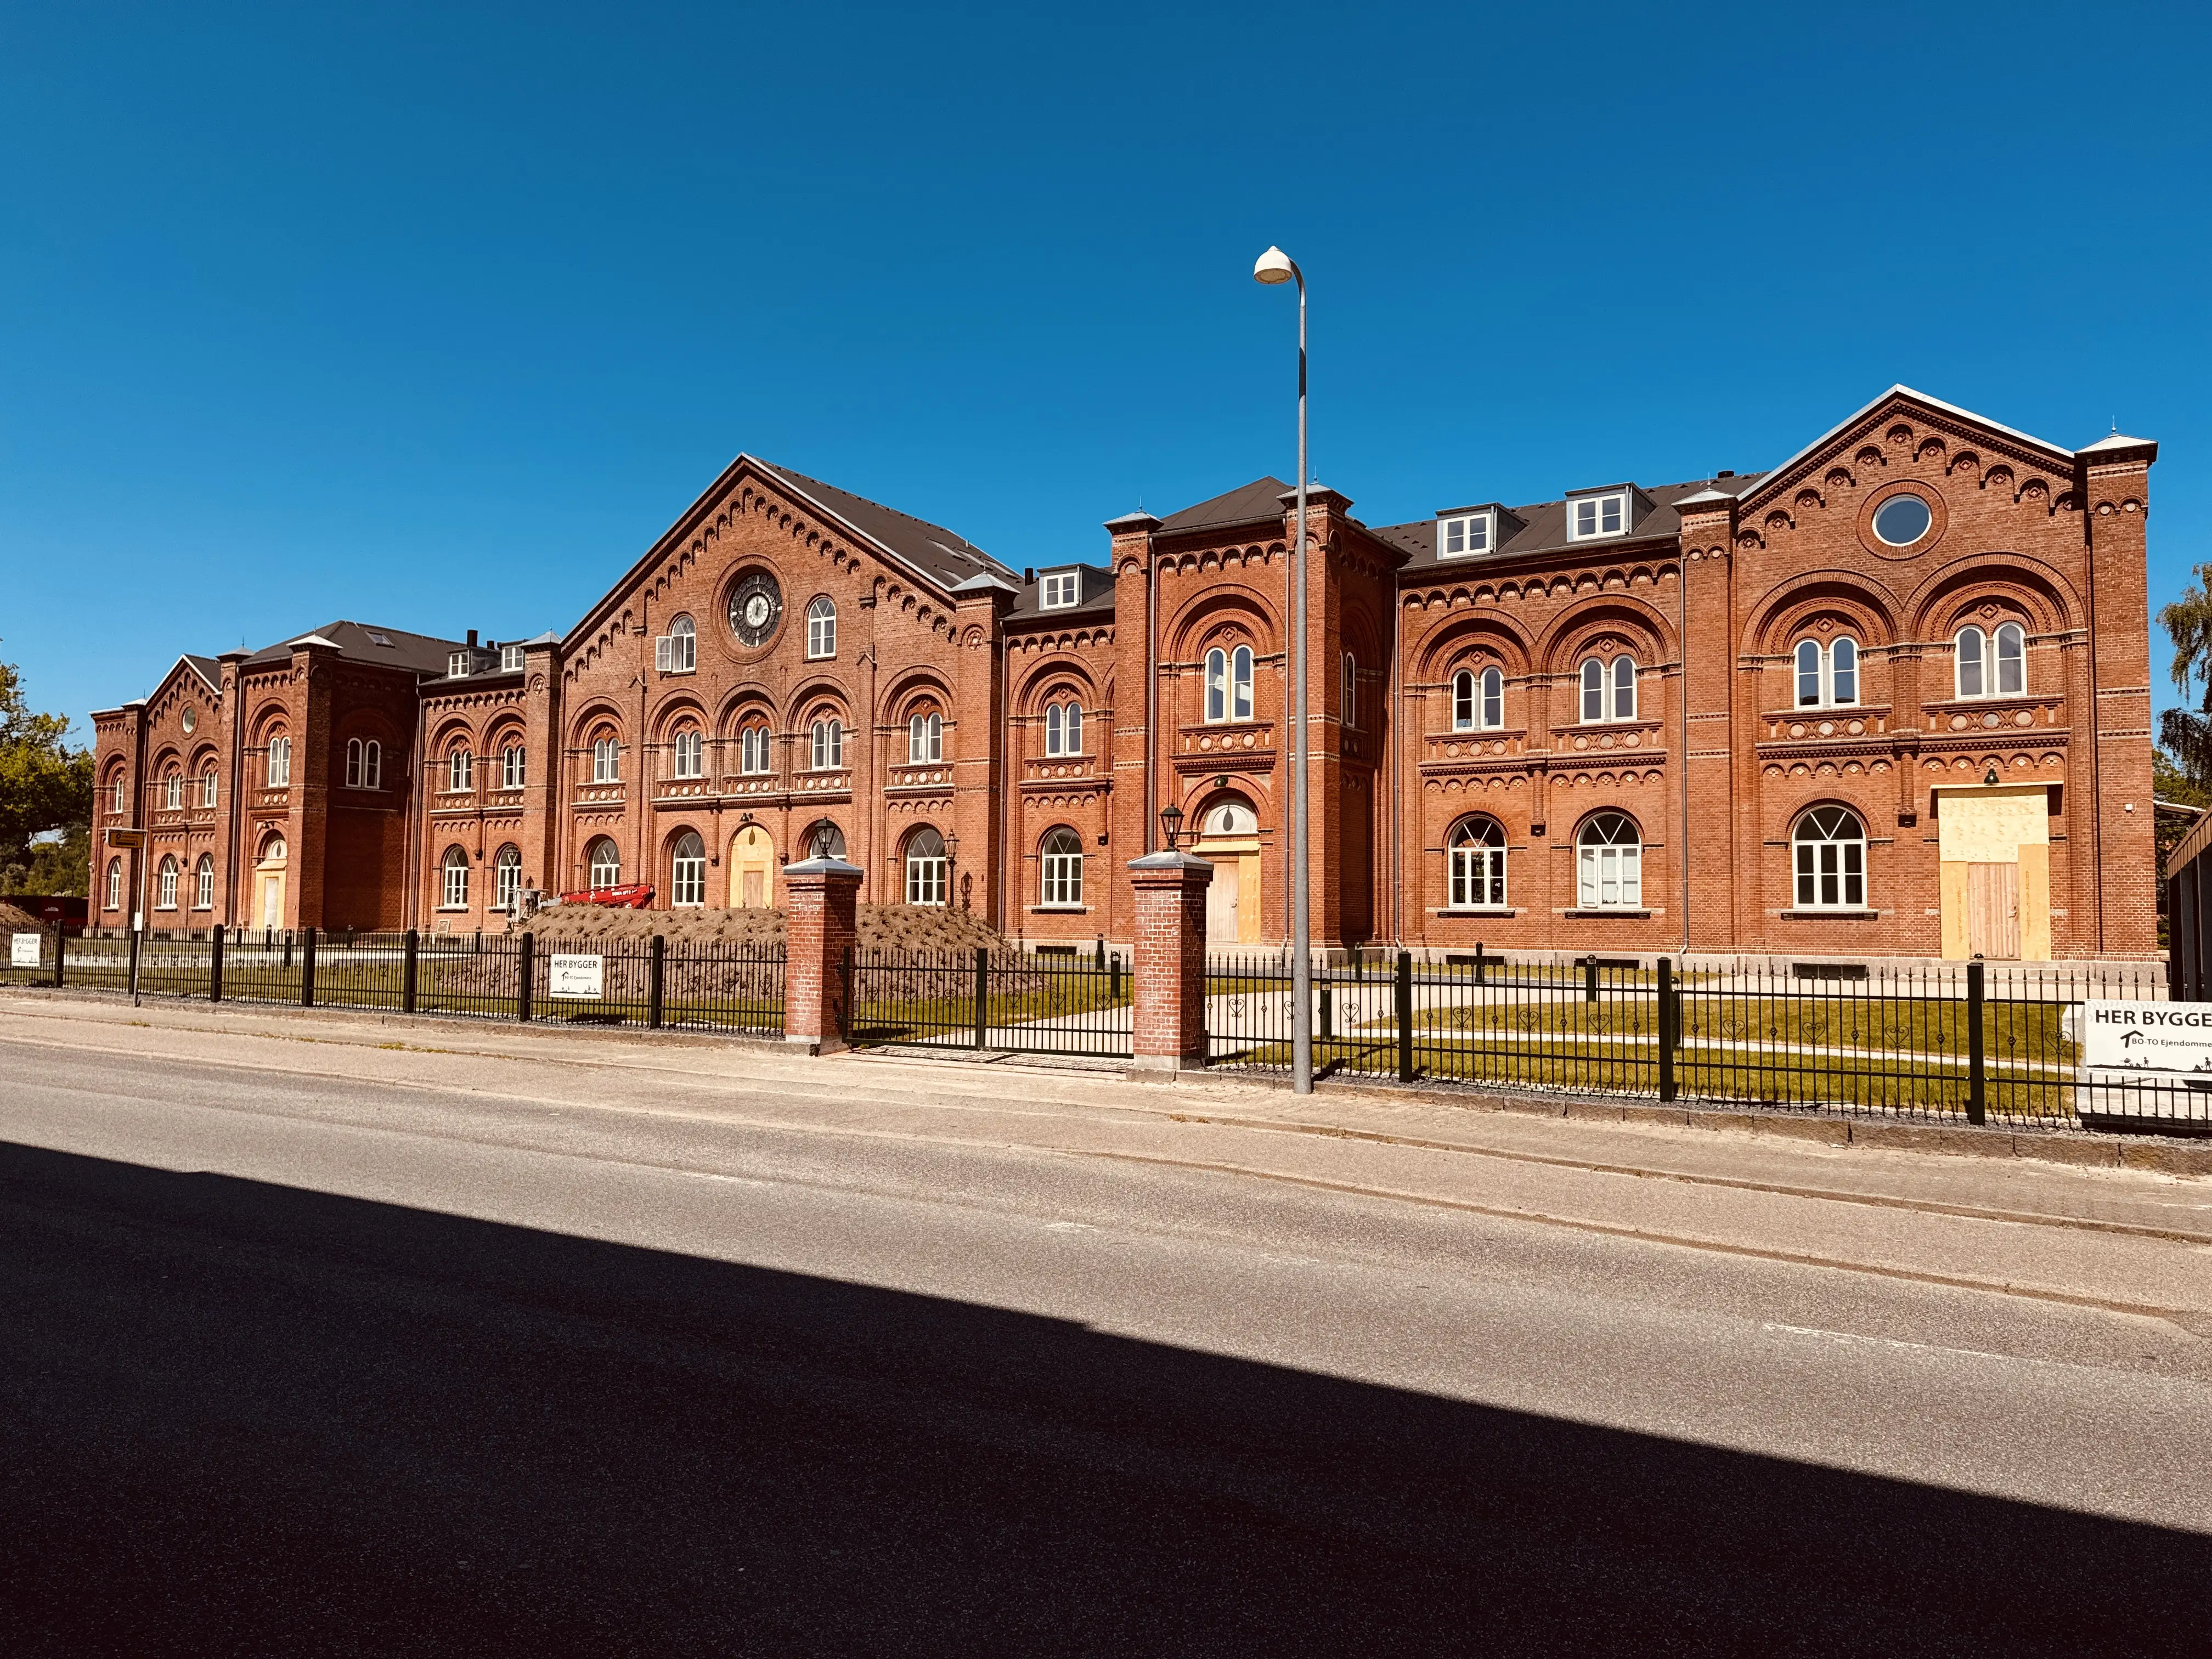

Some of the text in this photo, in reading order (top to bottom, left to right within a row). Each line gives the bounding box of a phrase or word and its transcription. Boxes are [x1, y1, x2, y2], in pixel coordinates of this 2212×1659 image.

[569, 960, 597, 968] BYGGER
[2096, 1009, 2212, 1027] HER BYGGE
